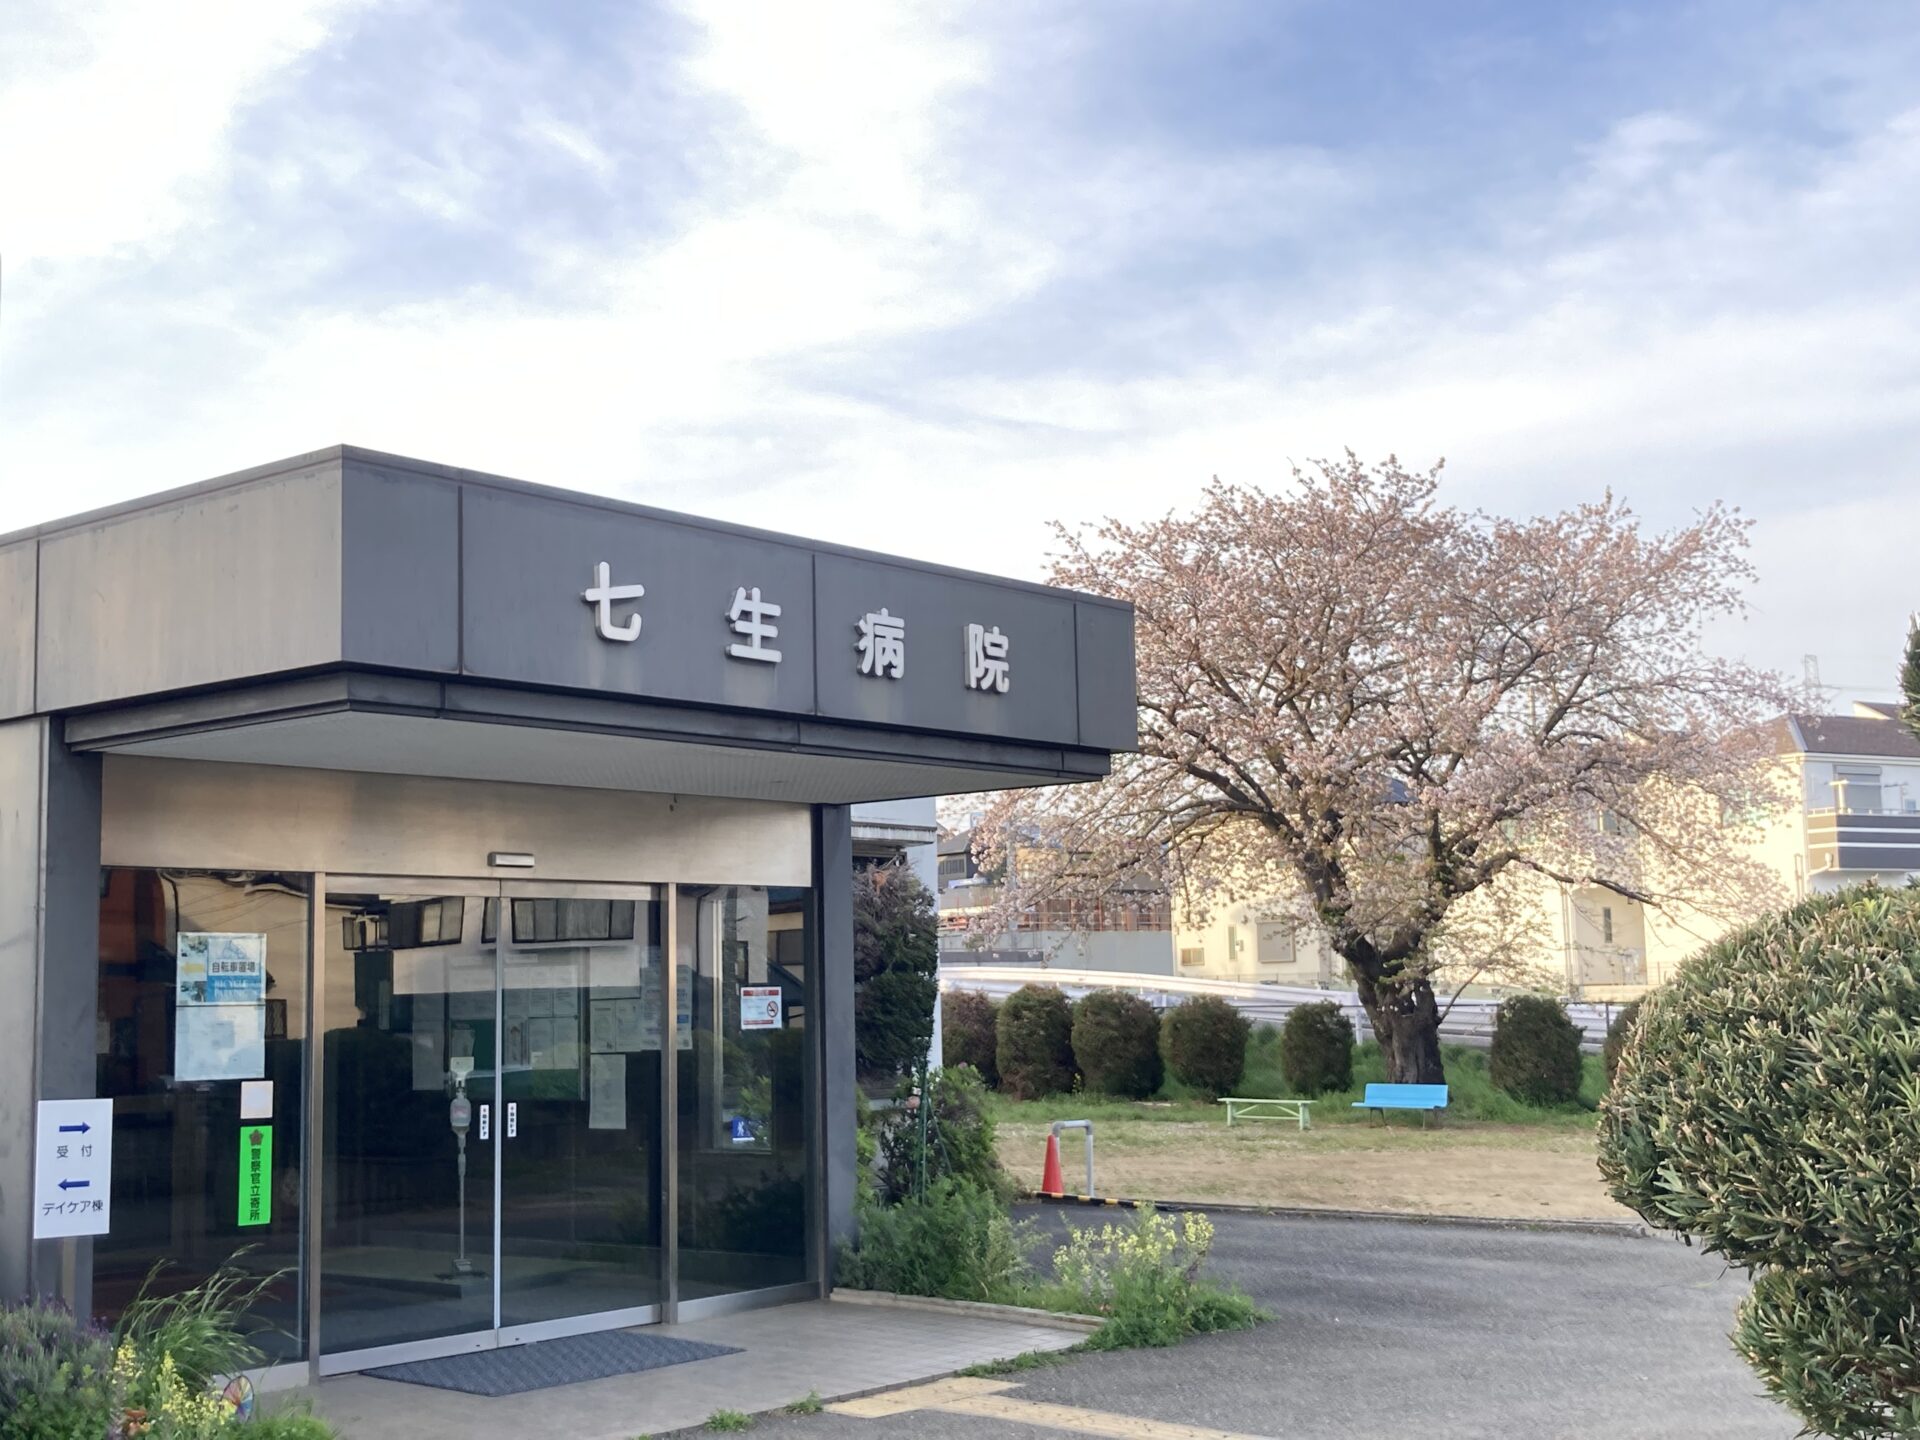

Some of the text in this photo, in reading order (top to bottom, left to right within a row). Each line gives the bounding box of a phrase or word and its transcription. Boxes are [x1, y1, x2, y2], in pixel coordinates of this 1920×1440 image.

[581, 561, 1010, 693] 七生病院
[56, 1144, 93, 1159] 受付
[250, 1147, 261, 1221] 警察官立寄所
